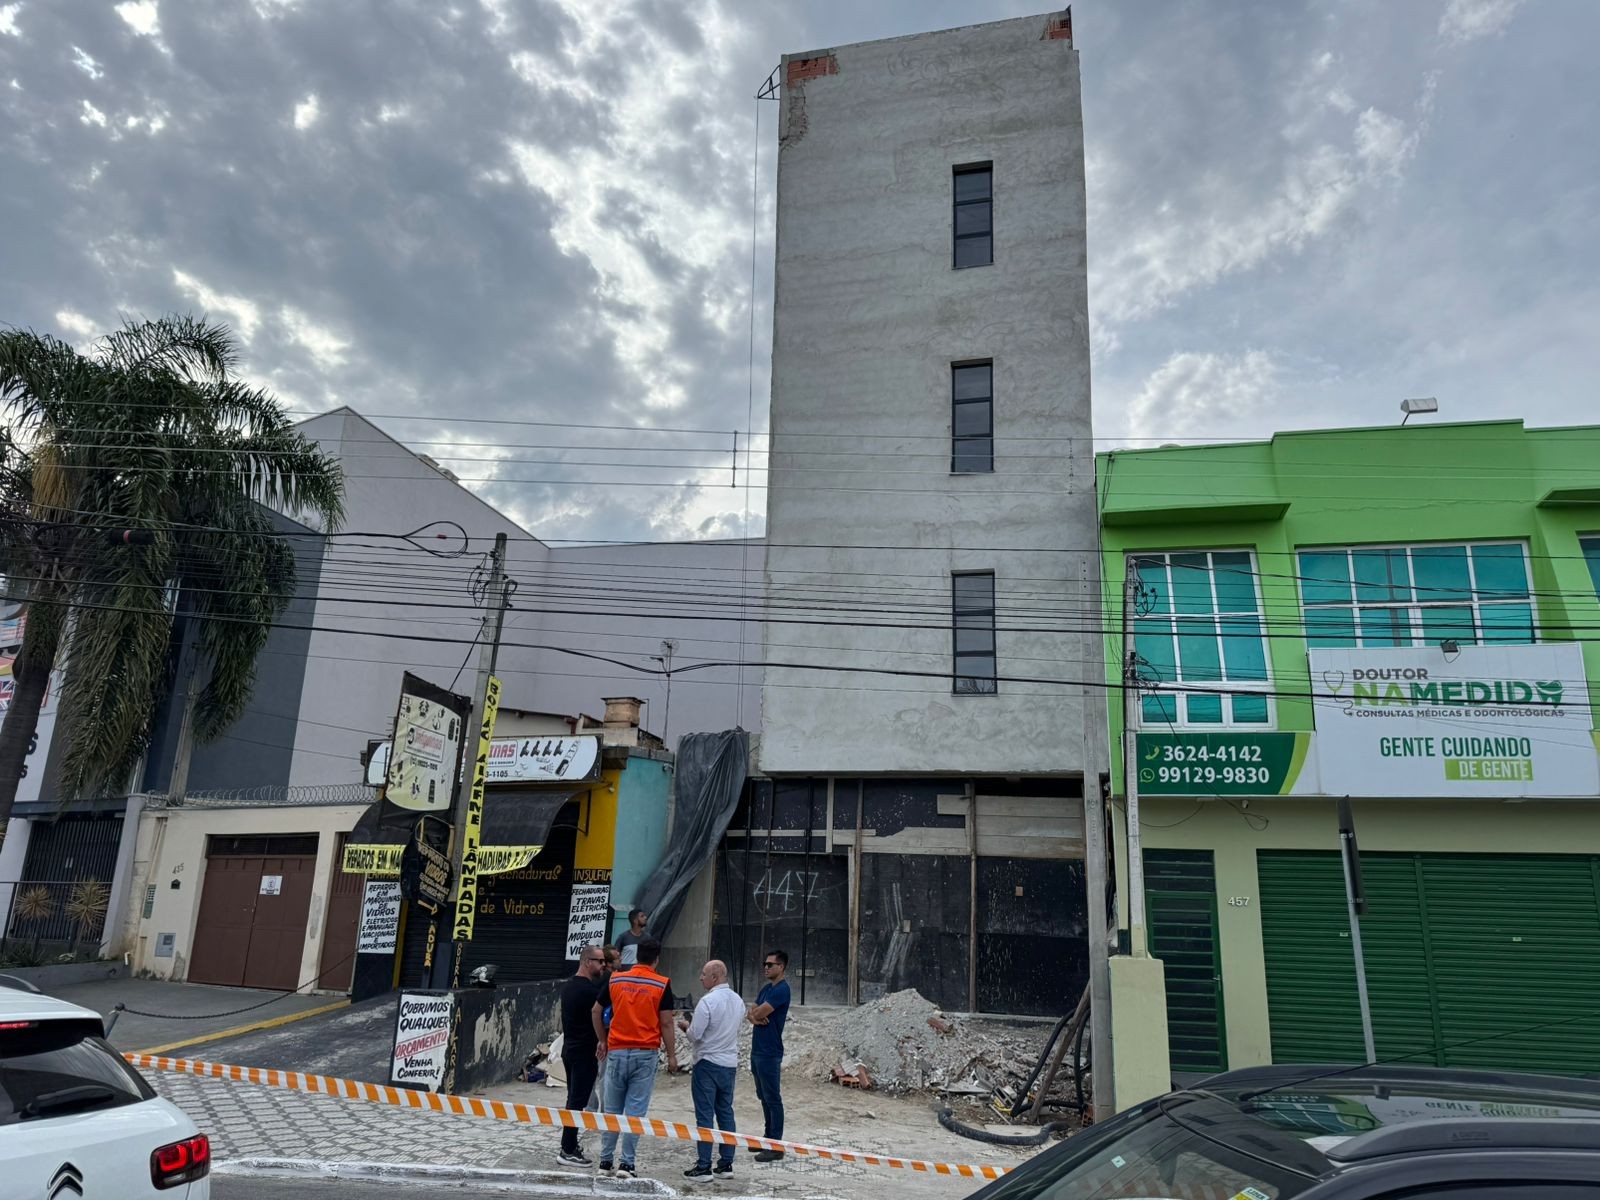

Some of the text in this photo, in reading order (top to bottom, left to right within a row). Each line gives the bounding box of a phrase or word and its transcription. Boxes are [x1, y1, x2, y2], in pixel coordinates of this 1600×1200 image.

[1353, 668, 1429, 681] DOUTOR
[1356, 709, 1414, 718] CONSULTAS
[1416, 708, 1462, 718] MÉDICAS
[1473, 708, 1566, 718] ODONTOLÓGICAS
[1163, 745, 1262, 761] 3624-4142
[1379, 737, 1532, 757] GENTE CUIDANDO
[1158, 767, 1270, 783] 99129-9830
[1459, 760, 1530, 779] DE GENTE
[346, 849, 375, 870] REPAROS
[377, 849, 388, 870] EM
[389, 849, 401, 870] MA
[477, 850, 512, 871] HADURAS
[574, 869, 612, 881] INSULFILM
[571, 886, 609, 896] FECHADURAS
[753, 868, 819, 912] 447
[378, 902, 388, 910] DE
[480, 898, 545, 915] de Vidros
[576, 895, 607, 906] TRAVAS
[1227, 896, 1250, 906] 457
[366, 907, 396, 918] VIDROS
[569, 912, 607, 925] ALARMES
[360, 941, 396, 951] IMPORTADOS
[579, 939, 590, 947] DE
[400, 1001, 449, 1017] COBRIMOS
[400, 1015, 450, 1032] QUALQUER
[404, 1056, 433, 1067] VENHA
[397, 1065, 440, 1080] CONFERIR!
